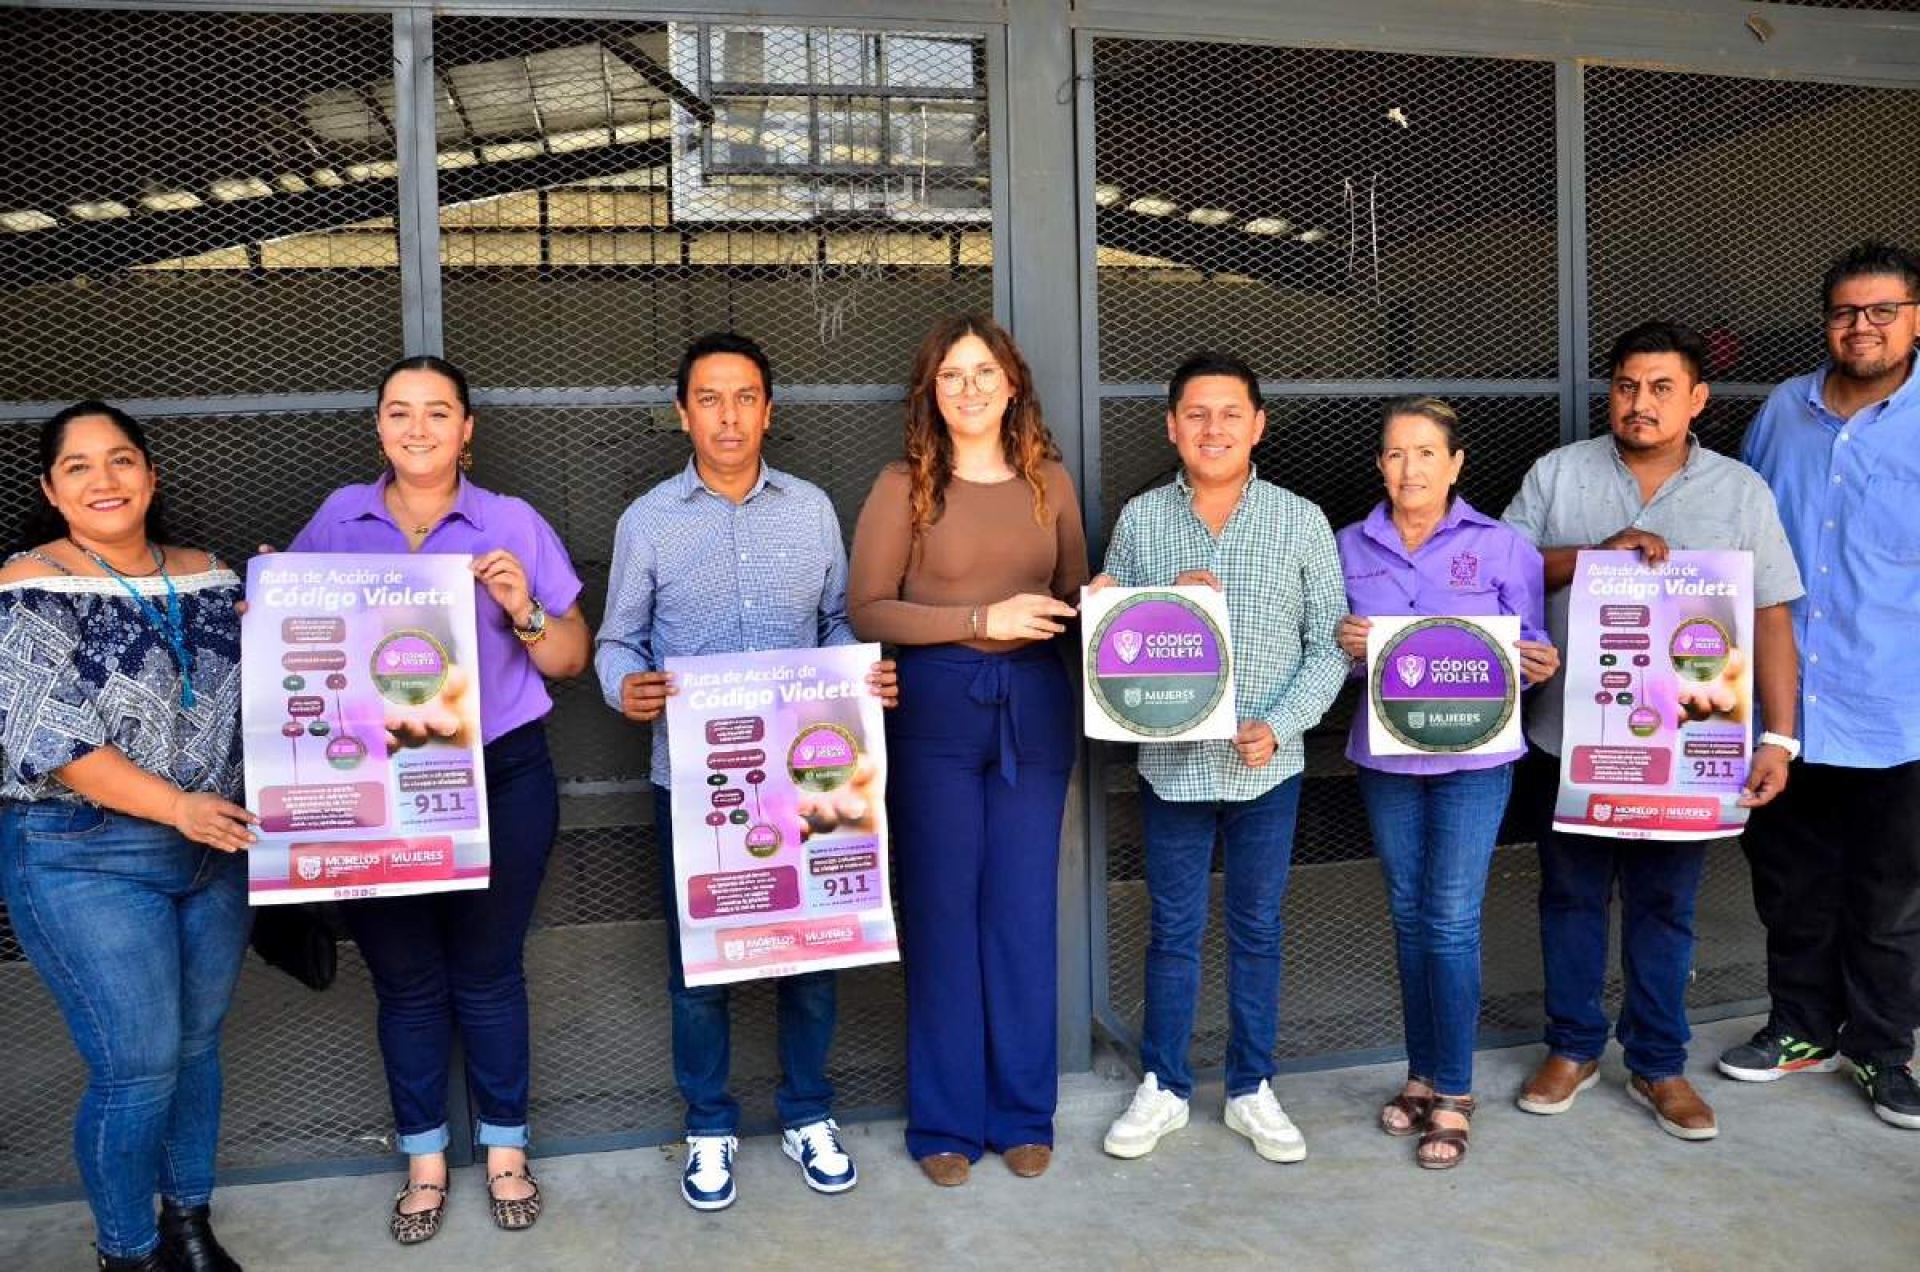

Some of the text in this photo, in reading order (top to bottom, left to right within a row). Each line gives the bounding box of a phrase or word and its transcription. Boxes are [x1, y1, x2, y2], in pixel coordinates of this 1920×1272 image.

[260, 568, 404, 585] Ruta de Acción de
[1682, 564, 1700, 577] de
[1589, 578, 1739, 600] Código Violeta
[265, 587, 456, 611] Código Violeta
[1146, 631, 1203, 646] CÓDIGO
[1146, 647, 1204, 659] VIOLETA
[1430, 656, 1489, 672] CÓDIGO
[684, 665, 816, 687] Ruta de Acción de
[1431, 672, 1490, 684] VIOLETA
[690, 686, 775, 711] Código
[1144, 690, 1196, 700] MUJERES
[1429, 713, 1480, 723] MUJERES
[1694, 761, 1734, 777] 911
[415, 792, 466, 814] 911
[325, 855, 380, 866] MORELOS
[392, 850, 444, 863] MUJERES
[823, 874, 870, 897] 911
